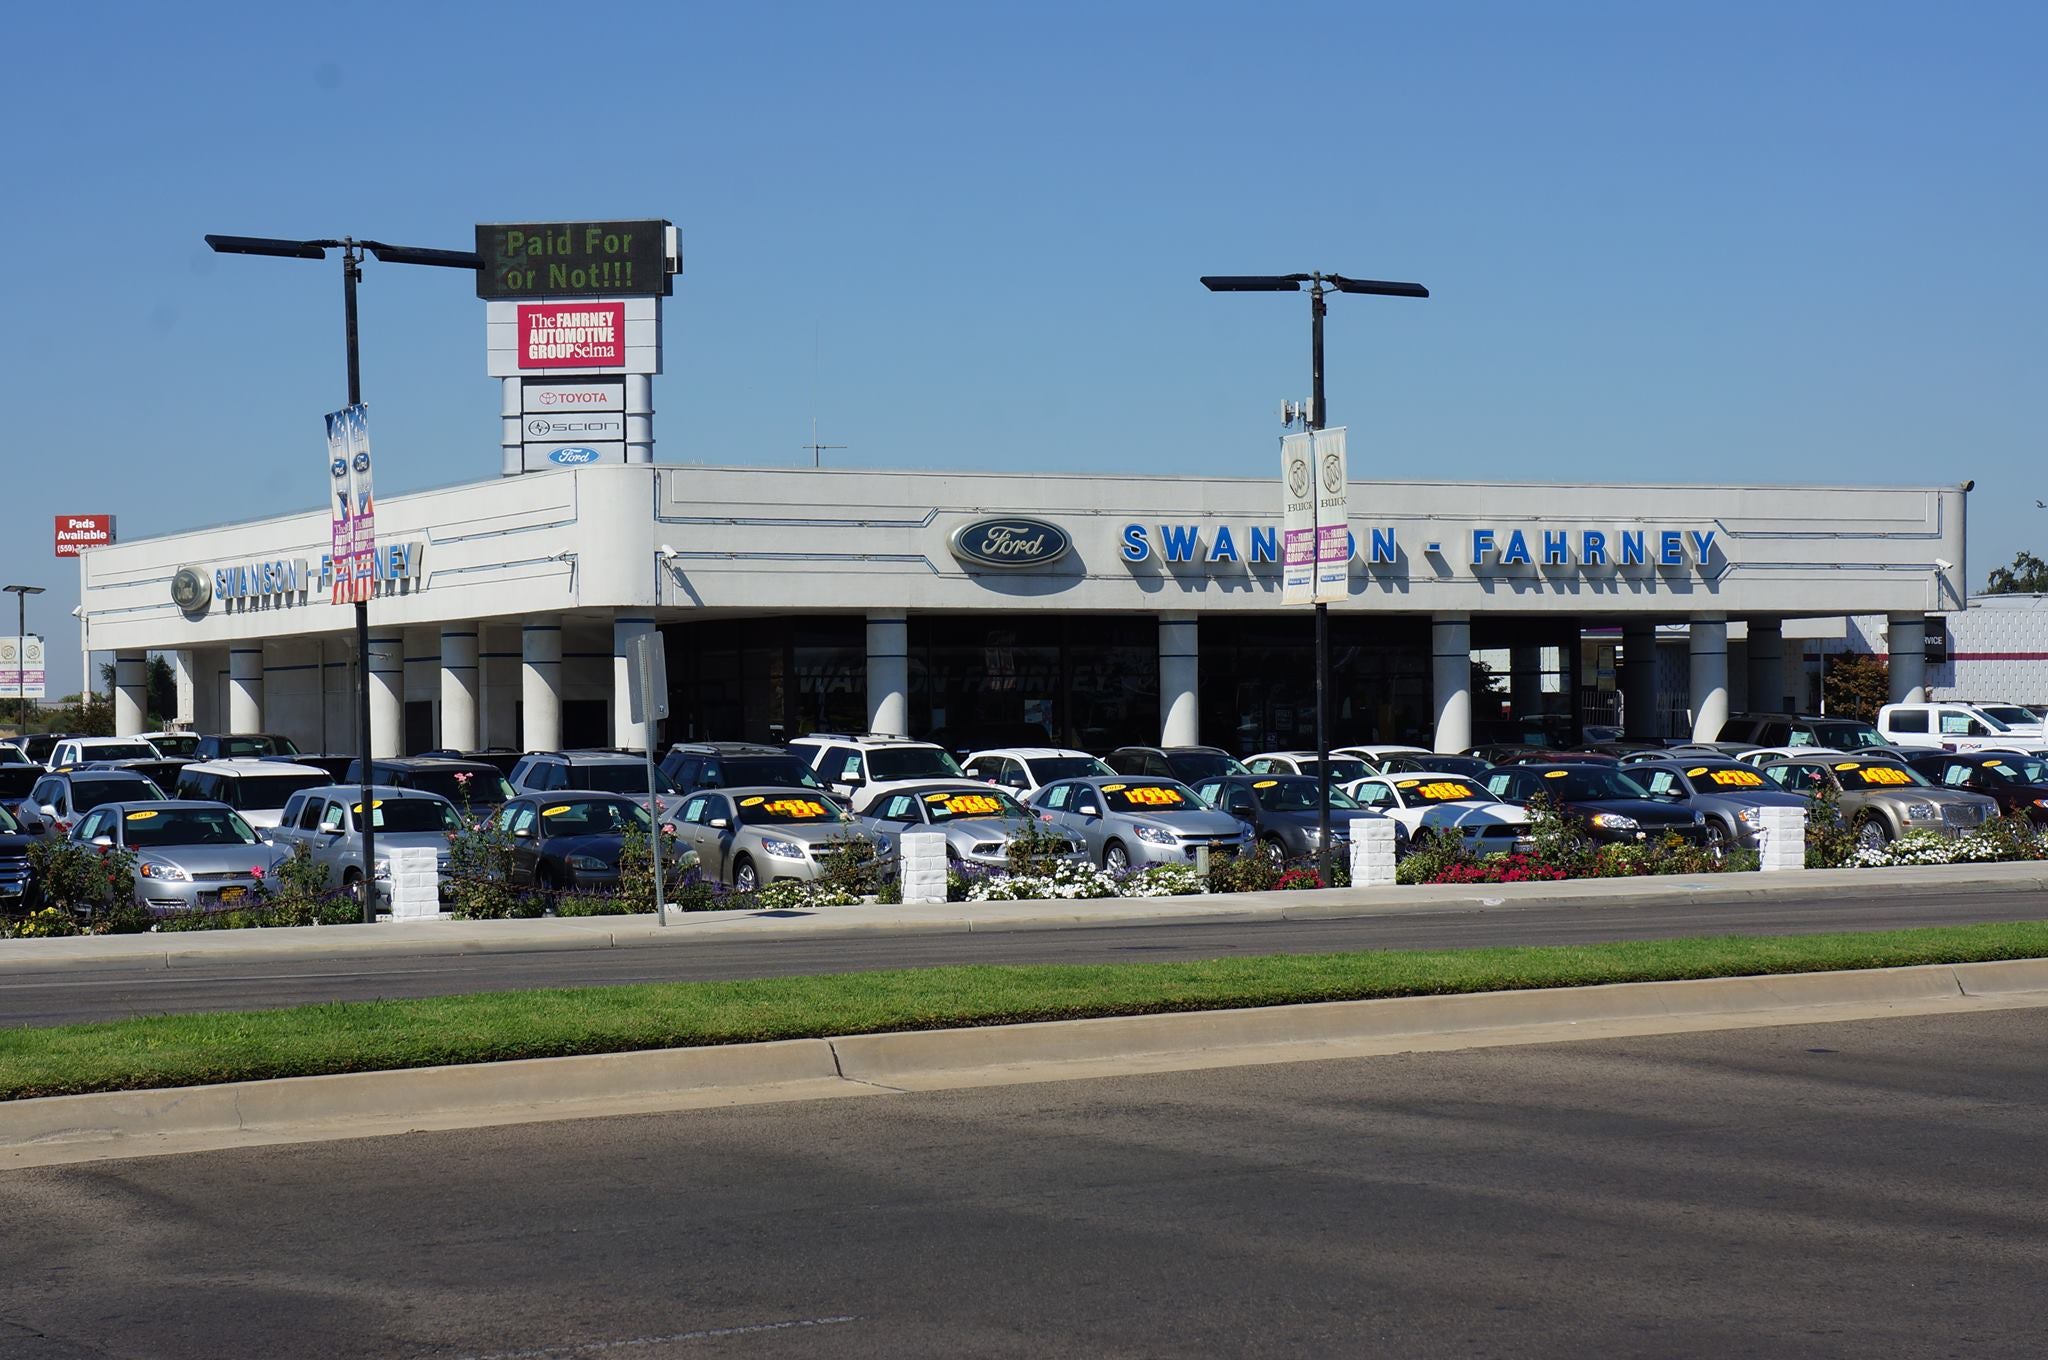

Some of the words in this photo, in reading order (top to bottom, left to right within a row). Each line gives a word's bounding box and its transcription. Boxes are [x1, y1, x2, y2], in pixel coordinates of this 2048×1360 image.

[507, 229, 572, 257] Paid
[585, 228, 632, 255] For
[507, 269, 536, 290] or
[549, 261, 632, 289] Not!!!
[528, 313, 556, 329] The
[556, 311, 614, 328] FAHRNEY
[529, 327, 615, 345] AUTOMOTIVE
[528, 343, 575, 360] GROUP
[574, 342, 615, 359] Selma
[558, 392, 608, 404] TOYOTA
[559, 448, 590, 462] Ford
[1287, 500, 1313, 513] BUICK
[1321, 496, 1347, 508] BUICK
[68, 518, 96, 529] Pads
[57, 529, 107, 541] Available
[981, 525, 1045, 556] Ford
[1122, 523, 1398, 564] SWANN
[1472, 528, 1717, 566] FAHRNEY
[214, 558, 298, 601] SWANSON
[321, 543, 411, 588] FNEY
